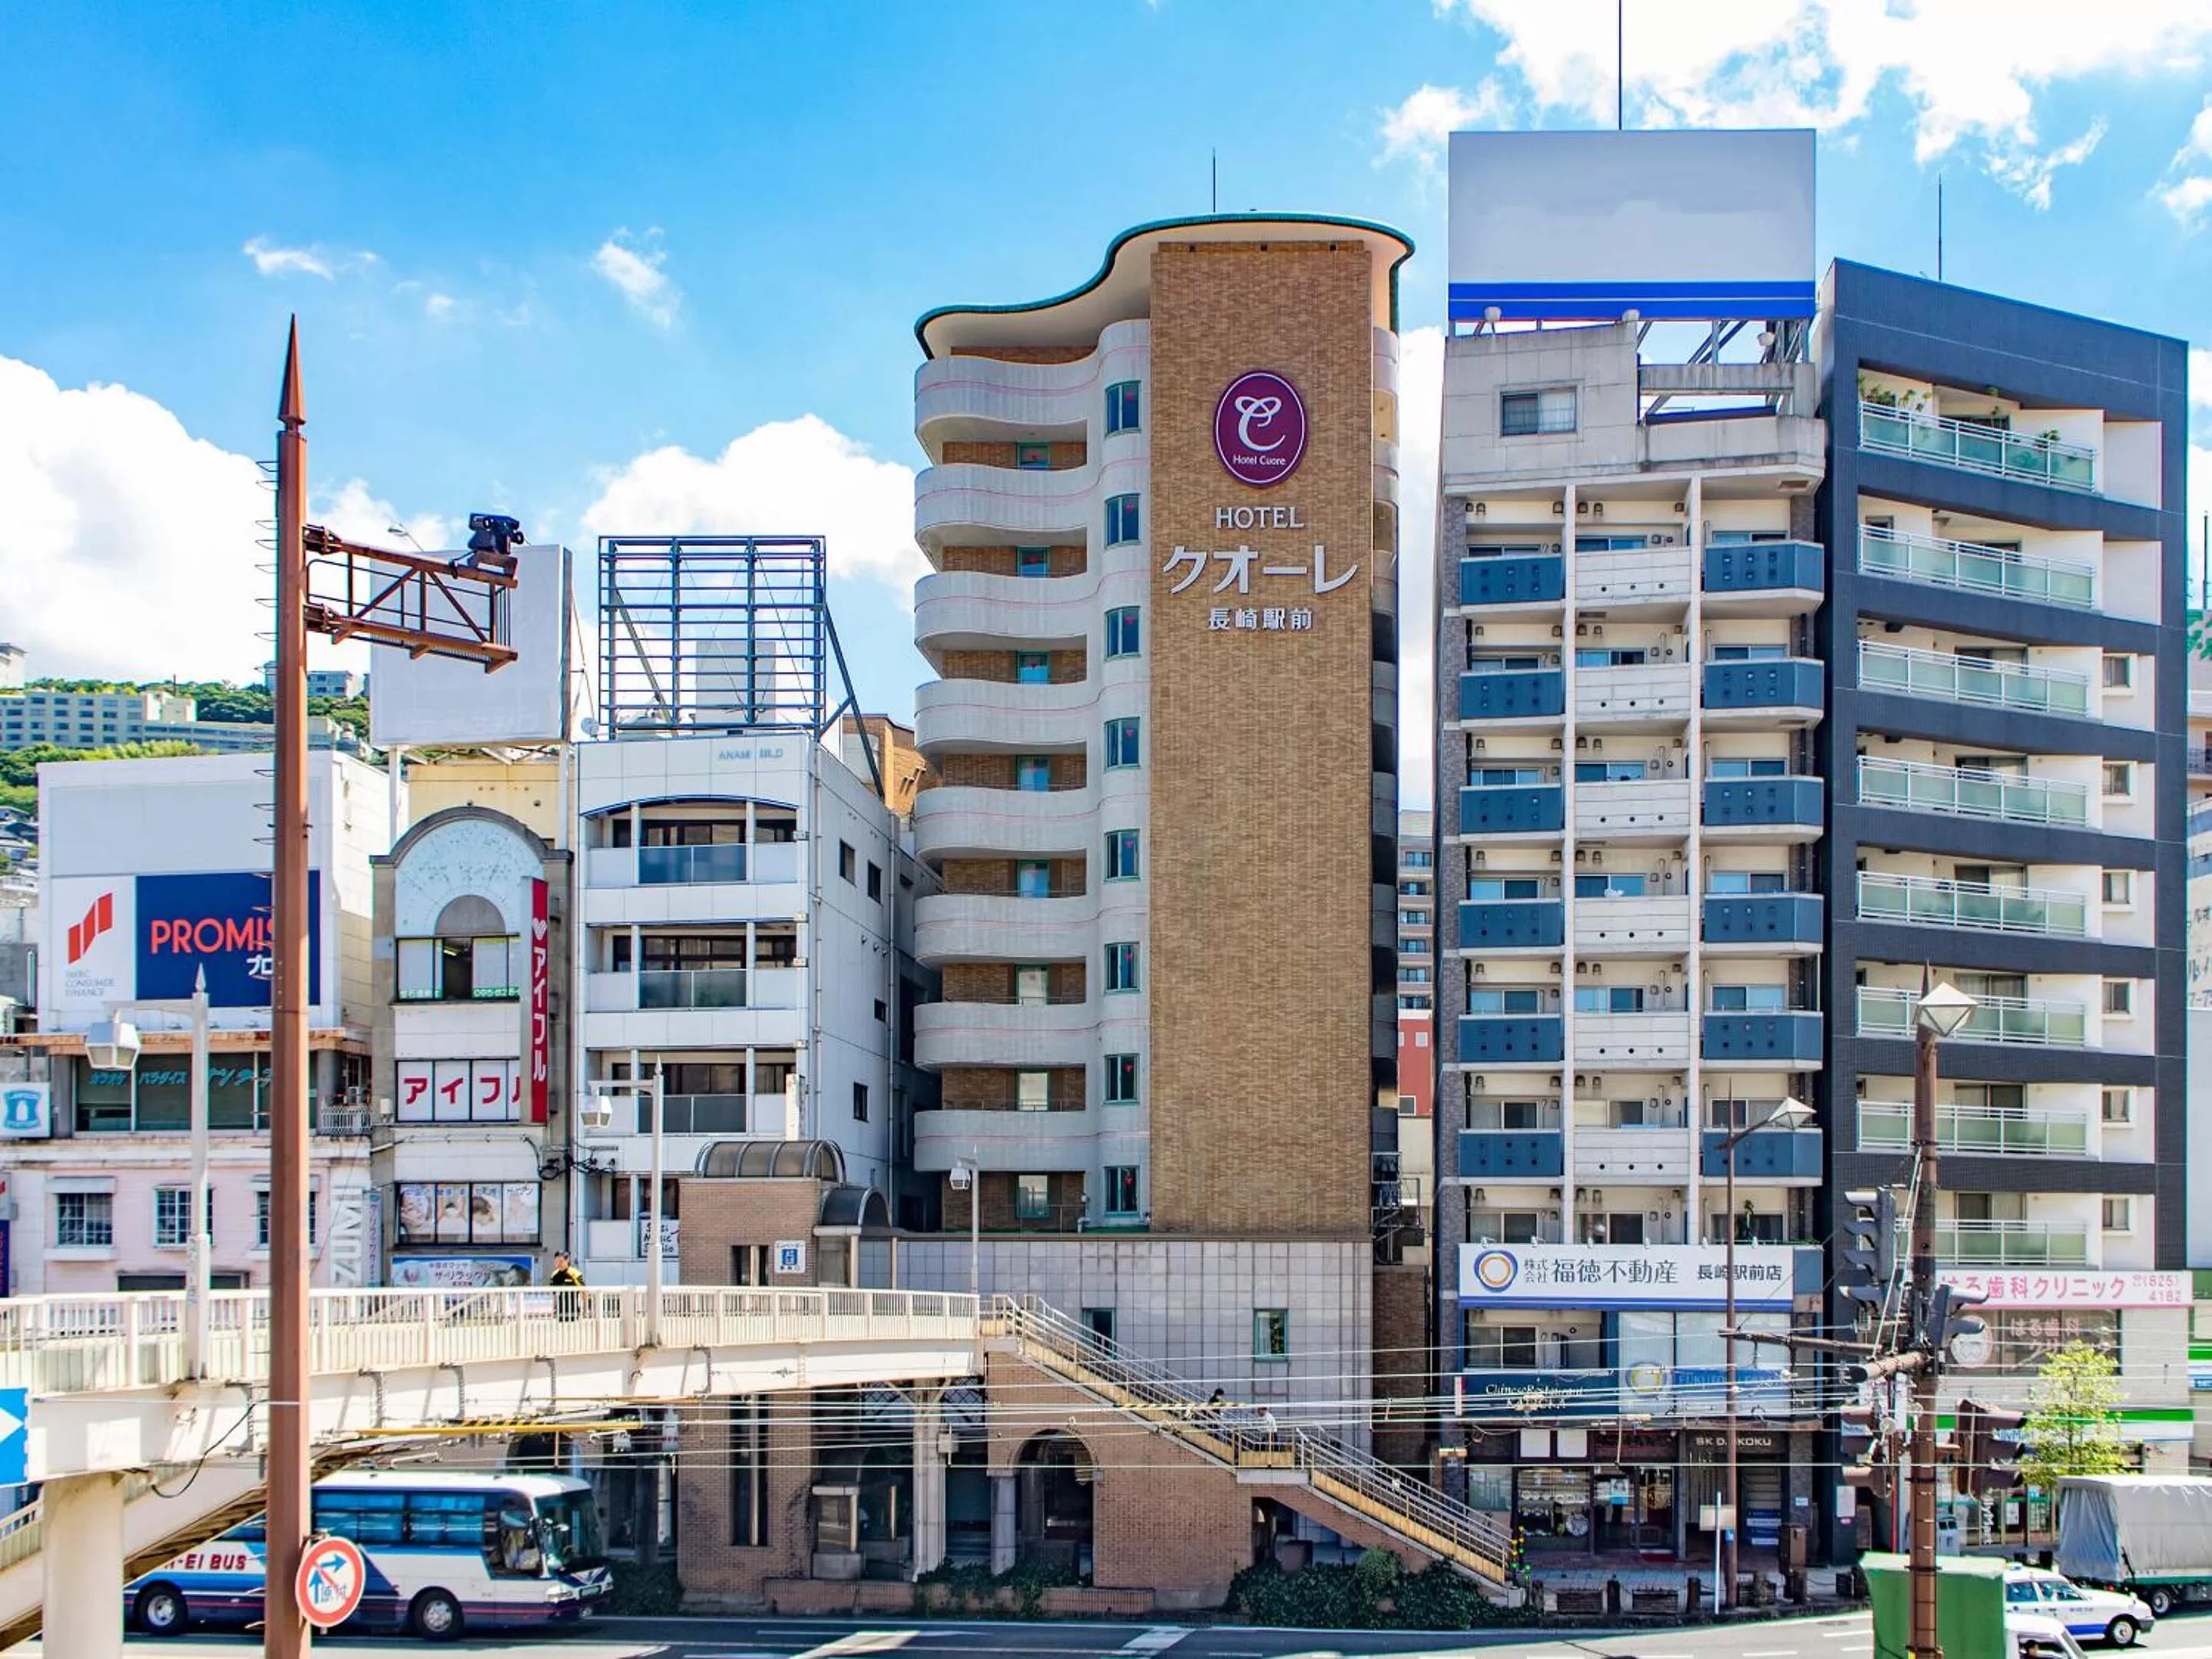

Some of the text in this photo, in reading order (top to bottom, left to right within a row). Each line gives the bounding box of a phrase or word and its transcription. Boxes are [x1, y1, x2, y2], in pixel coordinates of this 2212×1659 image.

[1233, 455, 1286, 465] Hotel Cuore
[1216, 507, 1304, 529] HOTEL
[1162, 545, 1358, 594] クオーレ
[1208, 608, 1313, 631] 長崎駅前
[151, 918, 273, 955] PROMI
[532, 946, 547, 1083] アイフル
[1551, 1258, 1679, 1284] 福徳不動産
[209, 1553, 247, 1570] BUS
